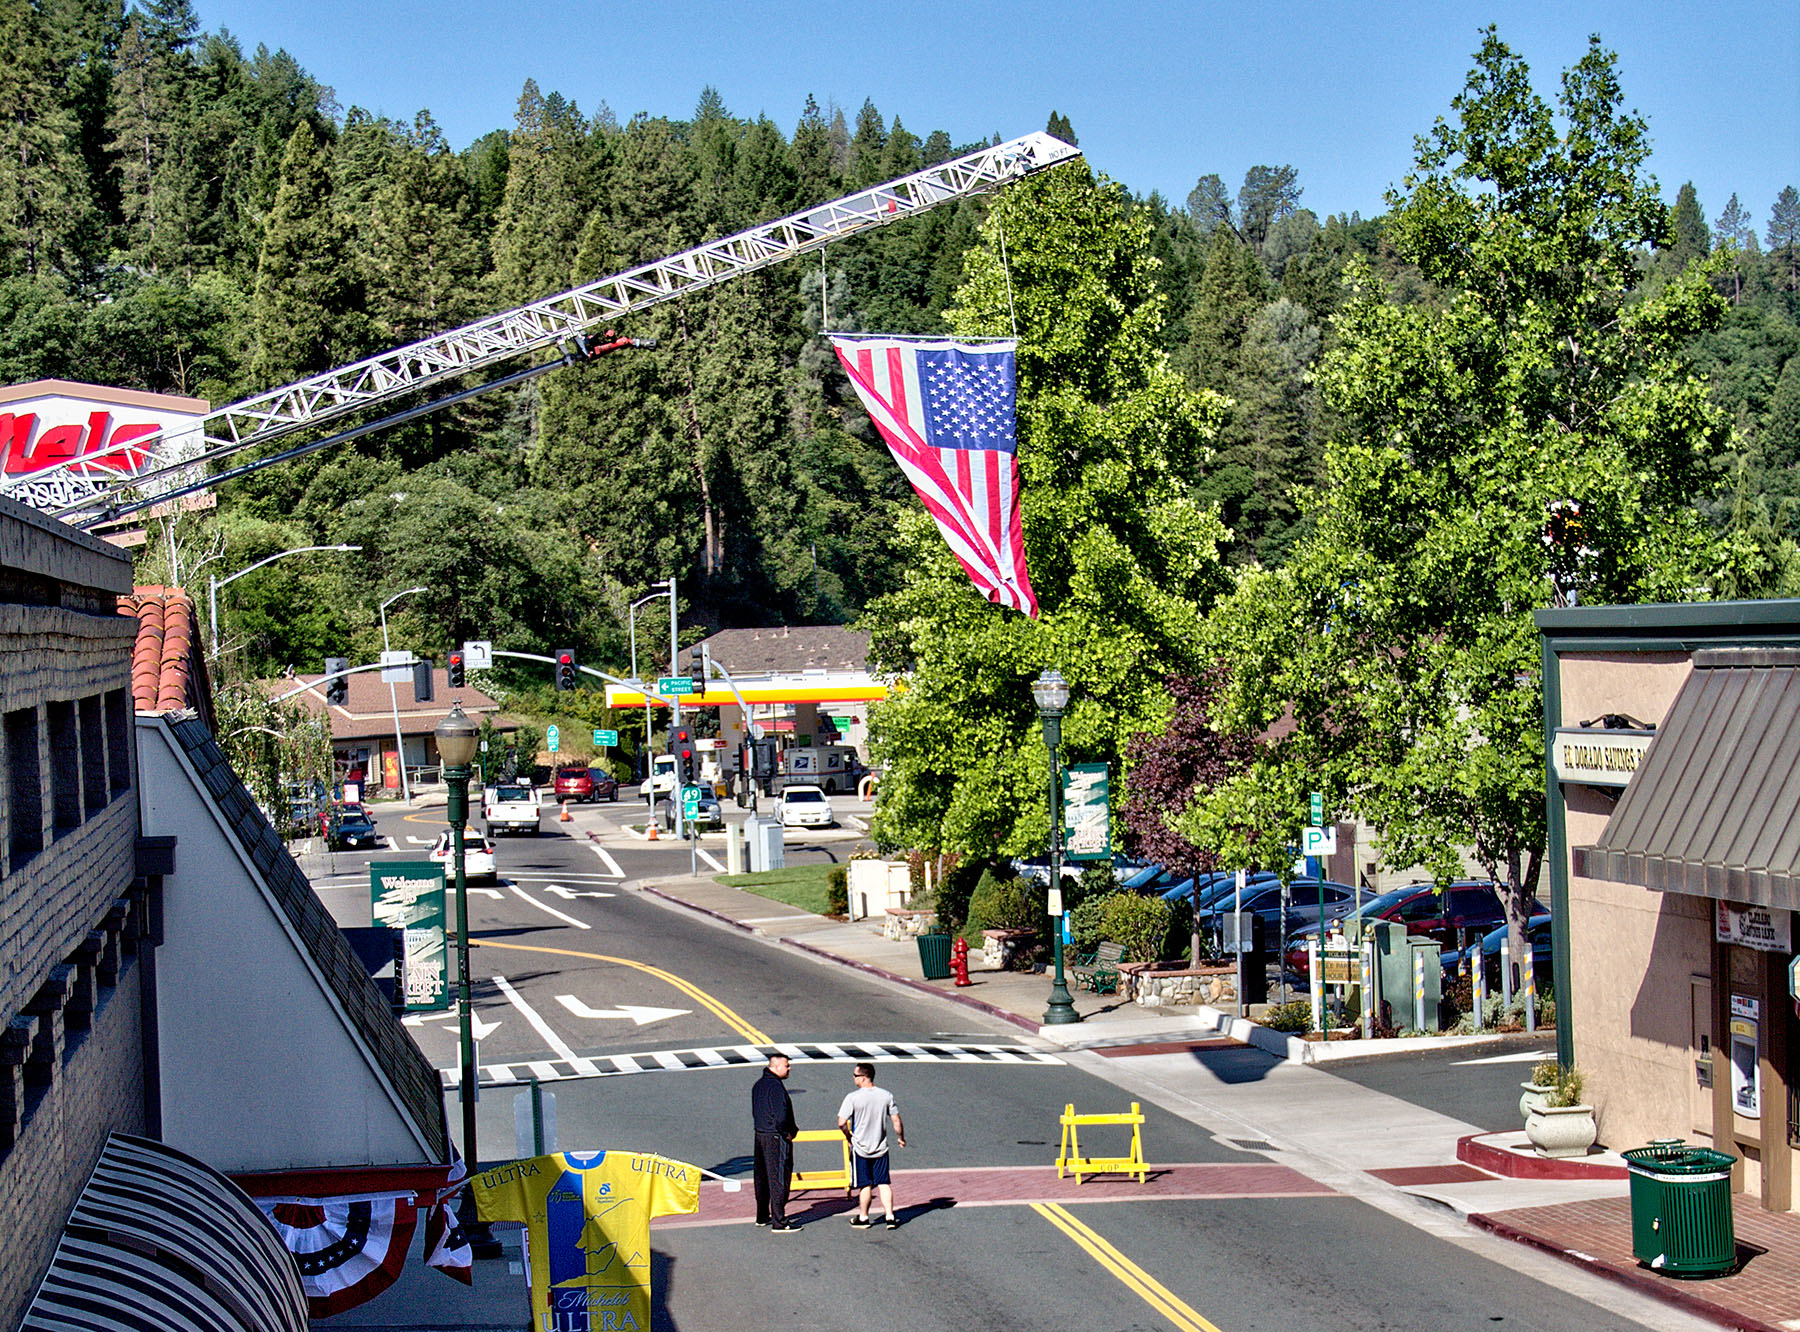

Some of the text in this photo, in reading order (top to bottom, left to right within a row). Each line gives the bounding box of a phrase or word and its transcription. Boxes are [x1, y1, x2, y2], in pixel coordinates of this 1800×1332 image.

[1574, 745, 1603, 771] DORADO
[1604, 746, 1636, 773] SAVINGS
[683, 789, 699, 800] 49
[380, 876, 435, 889] Welcome
[482, 1162, 541, 1189] ULTRA
[632, 1158, 688, 1182] ULTRA
[557, 1290, 632, 1309] Michelob
[541, 1310, 641, 1332] ULTRA
